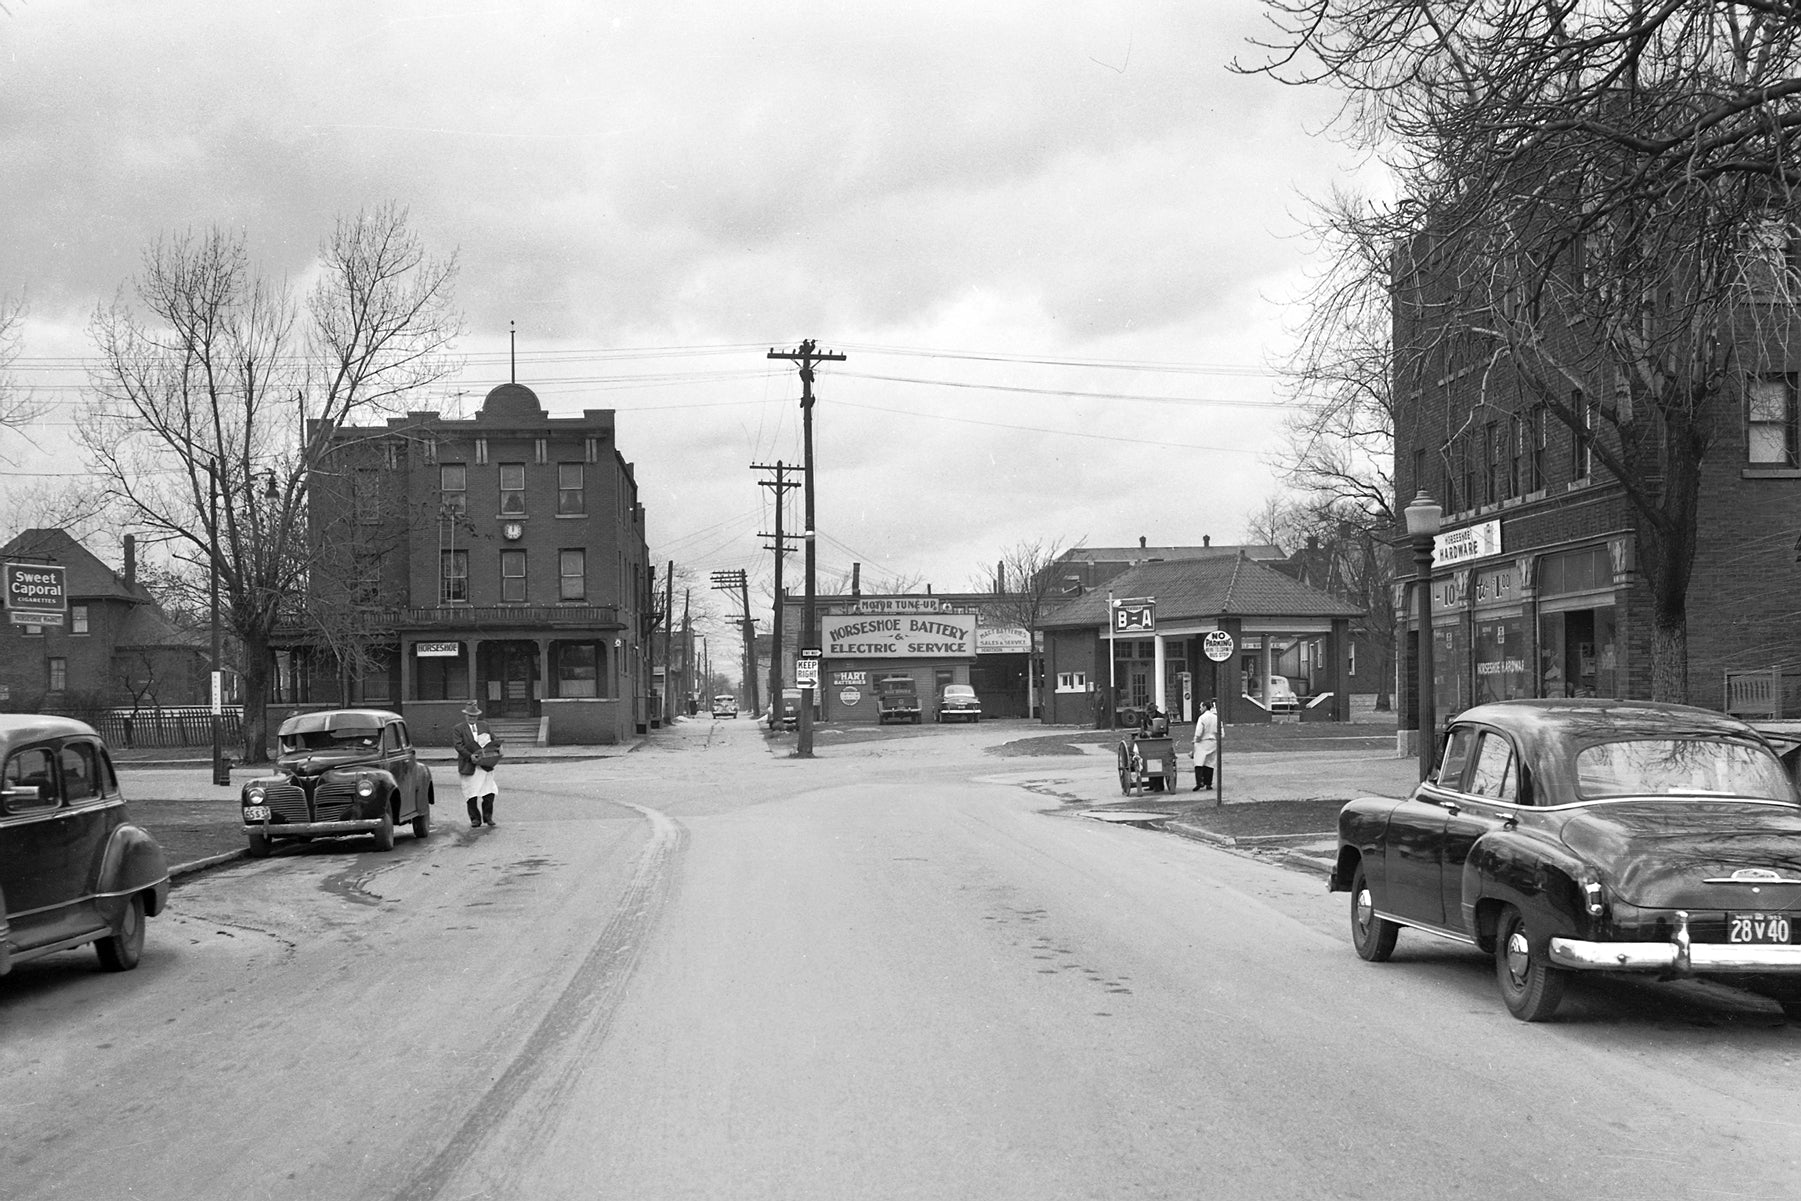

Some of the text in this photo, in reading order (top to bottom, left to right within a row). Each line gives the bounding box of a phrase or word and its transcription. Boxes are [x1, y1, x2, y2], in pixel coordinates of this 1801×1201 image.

[1444, 529, 1470, 545] HORSESHOE
[1440, 540, 1478, 561] HARDWARE
[15, 571, 57, 584] Sweet
[11, 582, 61, 596] Caporal
[1476, 578, 1489, 601] to
[861, 600, 893, 610] MOTOR
[829, 619, 969, 642] HORSESHOE BATTERY
[894, 633, 904, 641] &
[1212, 632, 1226, 640] NO
[418, 643, 458, 652] HORSESHOE
[1205, 638, 1232, 647] PARKING
[830, 643, 967, 654] ELECTRIC SERVICE
[797, 661, 817, 670] KEEP
[797, 670, 817, 678] RIGHT
[840, 671, 866, 681] HART
